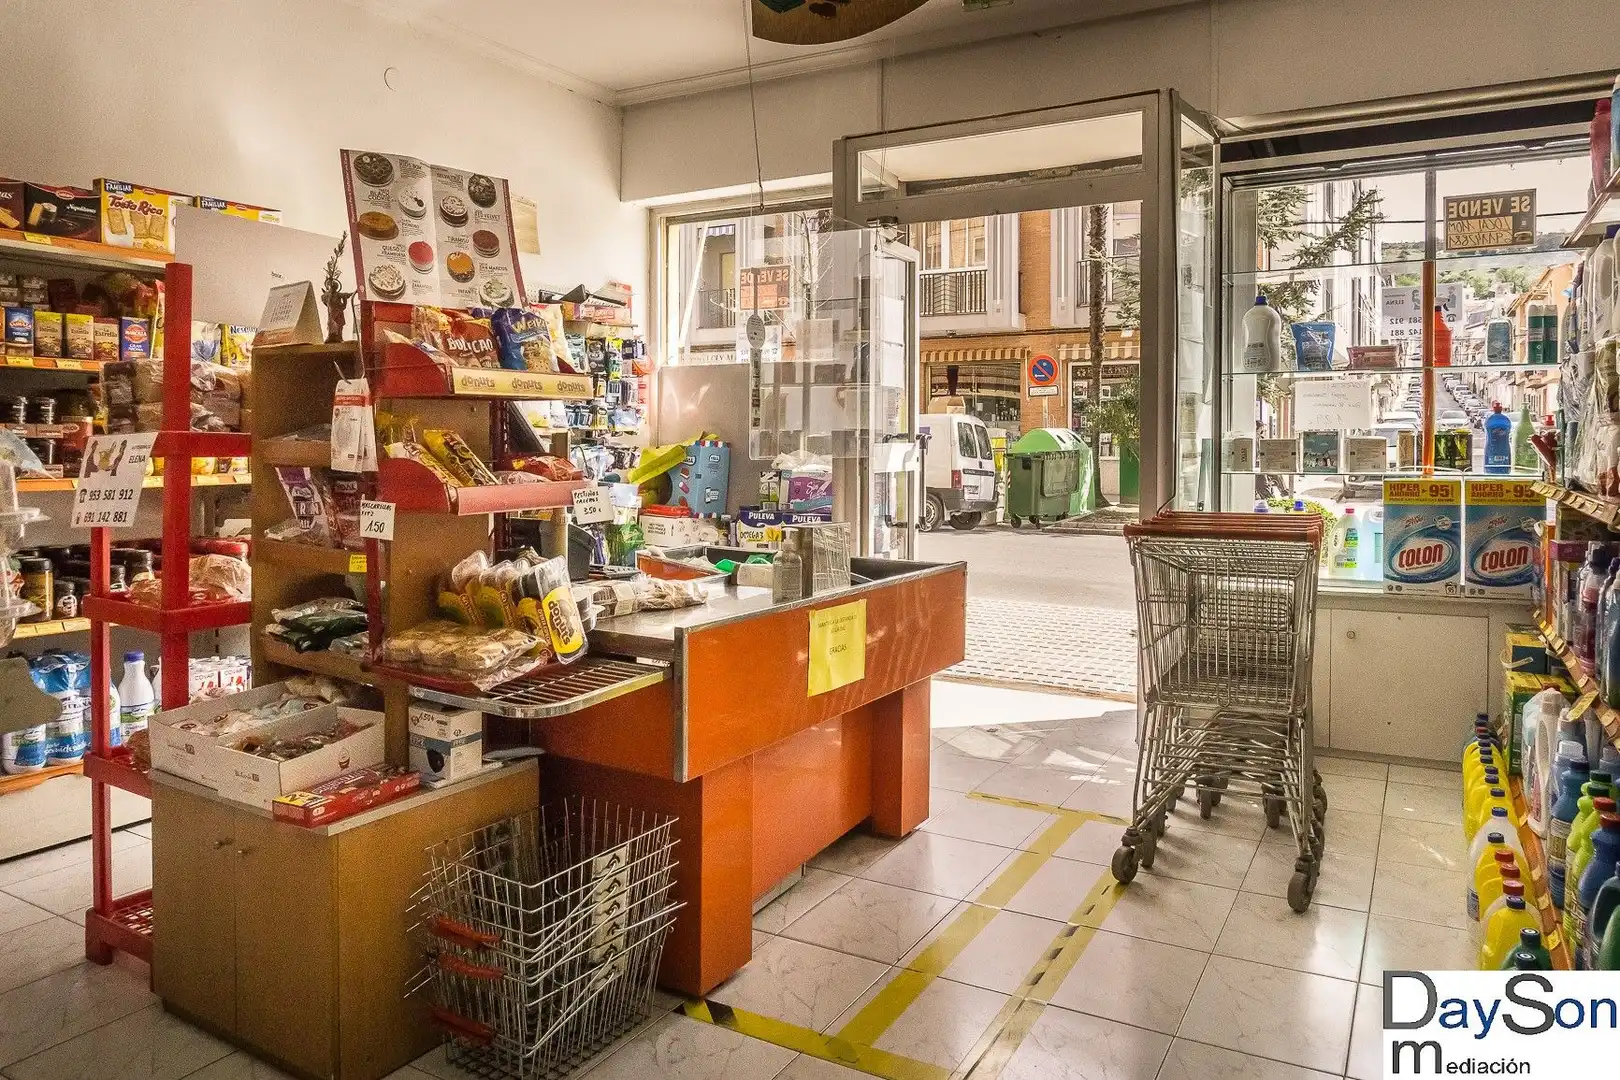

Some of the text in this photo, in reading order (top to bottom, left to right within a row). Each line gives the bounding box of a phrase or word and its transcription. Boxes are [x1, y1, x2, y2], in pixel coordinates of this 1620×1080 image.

[105, 183, 133, 192] FAMILIAR
[107, 195, 164, 216] Tosta Rica
[461, 375, 496, 388] donuts
[511, 378, 544, 391] donuts
[557, 381, 586, 393] donuts
[128, 455, 146, 464] ELENA
[1389, 483, 1420, 491] HIPER
[1429, 484, 1450, 498] 95
[1471, 483, 1503, 491] HIPER
[1513, 484, 1535, 498] 95
[88, 489, 133, 500] 953 581 912
[83, 511, 127, 522] 691 142 881
[748, 511, 775, 520] PULEVA
[792, 514, 822, 523] PULEVA
[1398, 543, 1443, 568] COLON
[1480, 546, 1529, 571] COLON
[547, 600, 571, 646] donuts
